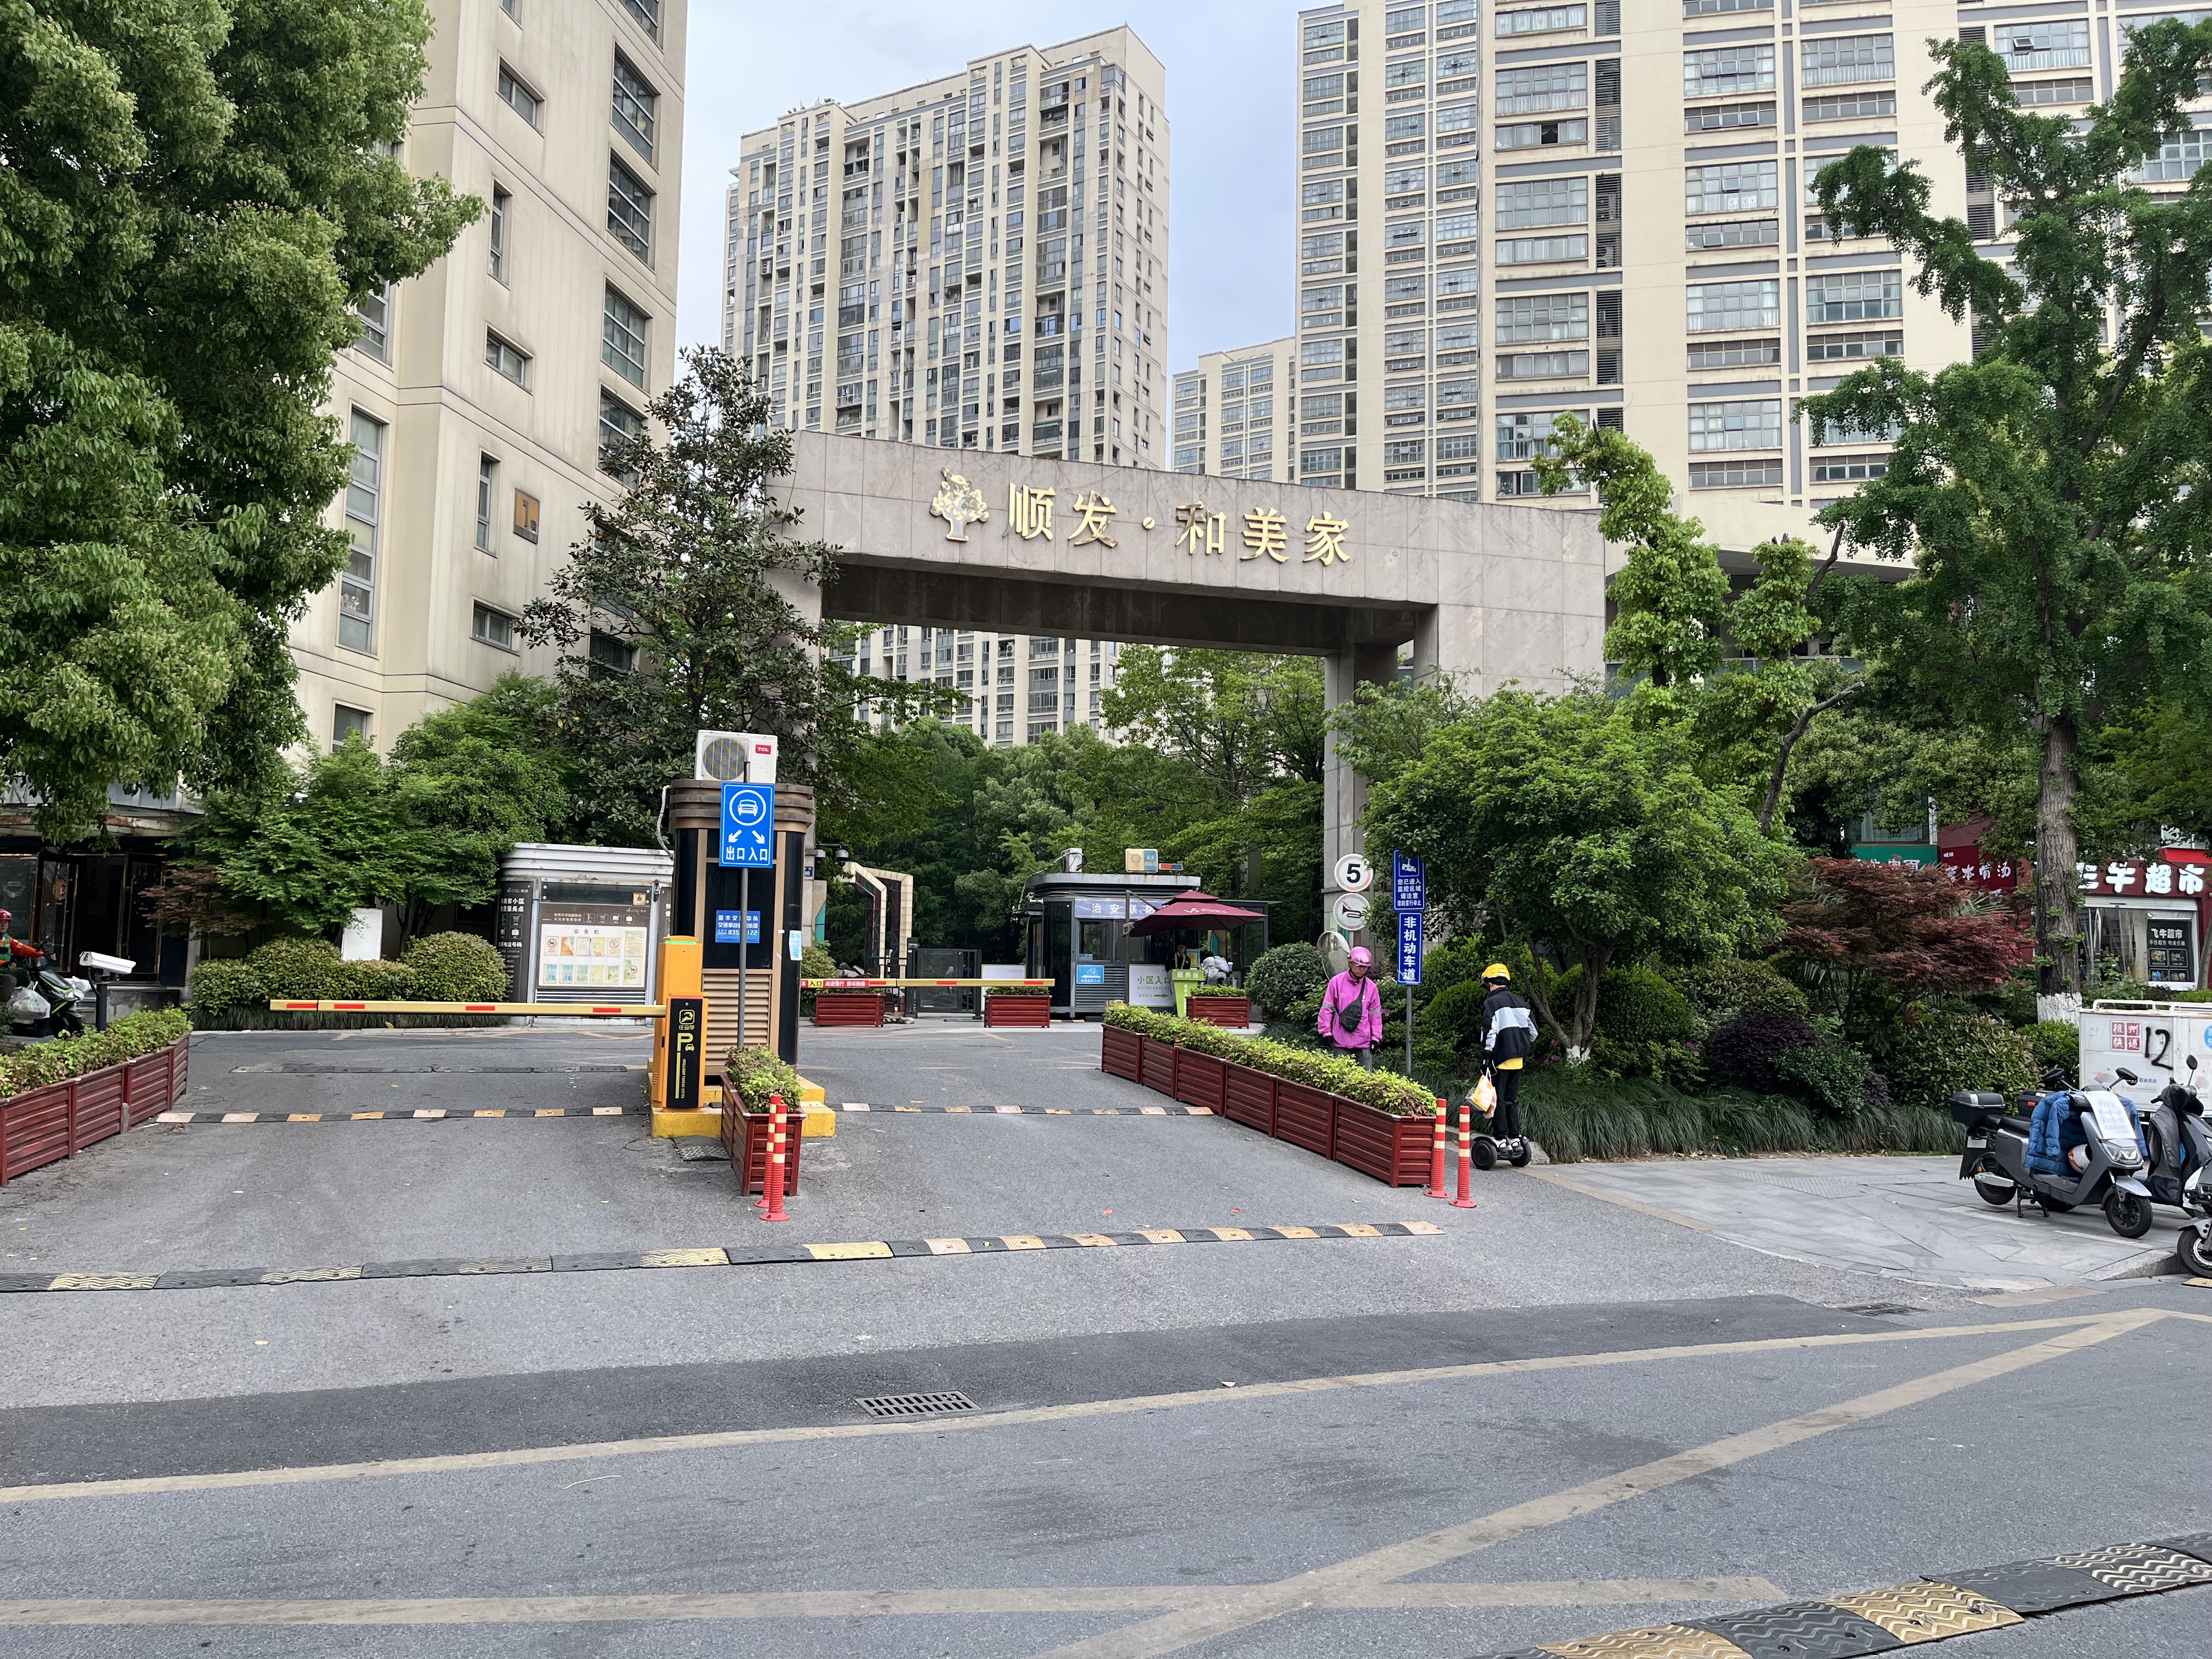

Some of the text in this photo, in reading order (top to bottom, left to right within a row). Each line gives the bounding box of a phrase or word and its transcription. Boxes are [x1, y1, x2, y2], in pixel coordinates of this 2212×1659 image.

[1002, 482, 1351, 567] 顺发·和美家
[1346, 863, 1361, 883] 5
[1092, 903, 1170, 915] 治安联防
[2151, 928, 2183, 939] 飞牛超市
[1403, 916, 1417, 980] 非机动车道
[1137, 975, 1171, 985] 小区入口
[2143, 1026, 2174, 1070] 12
